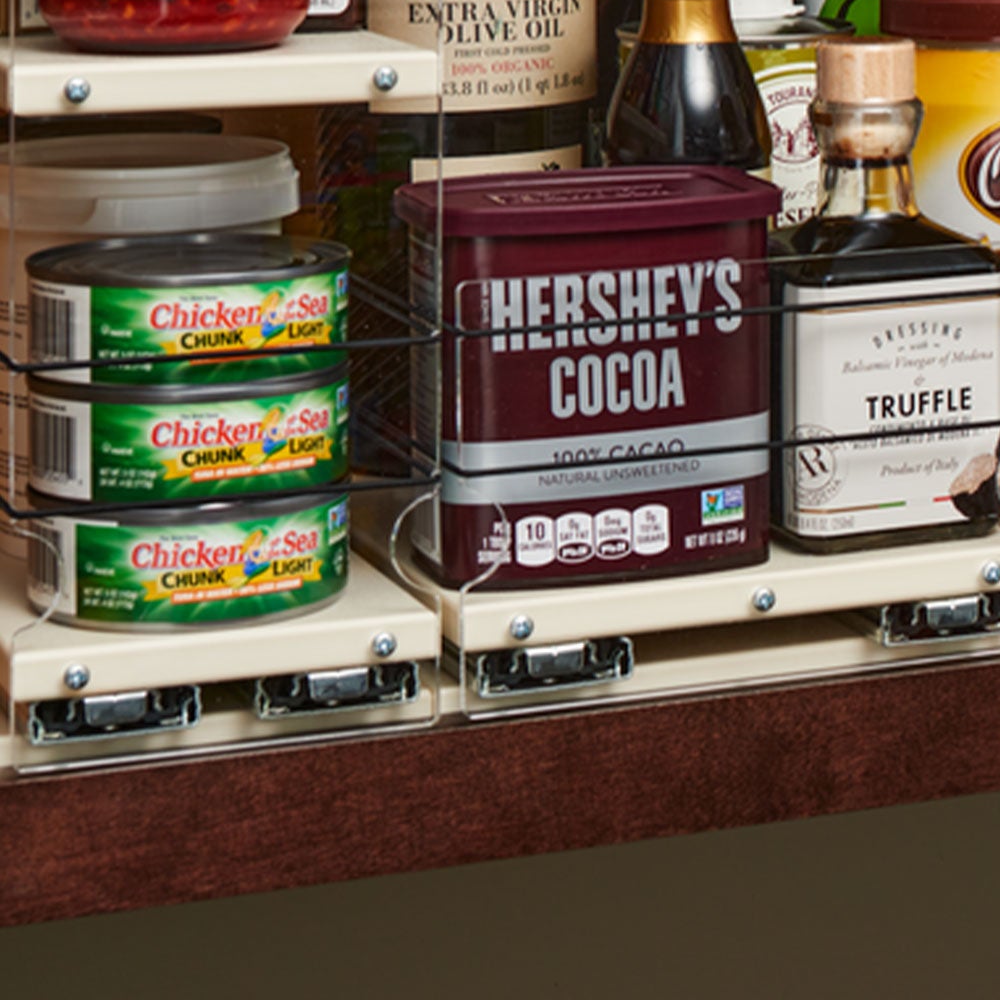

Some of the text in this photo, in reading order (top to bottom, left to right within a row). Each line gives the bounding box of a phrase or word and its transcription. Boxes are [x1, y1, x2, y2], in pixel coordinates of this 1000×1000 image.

[408, 1, 497, 25] EXTRA
[525, 18, 565, 39] OIL
[491, 57, 555, 74] ORGANIC
[150, 300, 262, 330] Chicken
[297, 293, 328, 320] Sea
[491, 257, 743, 353] HERSHEY'S
[181, 321, 325, 350] CHUNK LIGHT
[872, 321, 962, 350] DRESSING
[841, 348, 994, 375] Balsamic Vinegar of Modena
[550, 347, 686, 419] COCOA
[866, 386, 973, 420] TRUFFLE
[151, 418, 263, 448] Chicken
[298, 408, 329, 431] Sea
[181, 447, 246, 467] CHUNK
[288, 436, 325, 454] LIGHT
[608, 438, 686, 460] CACAO
[538, 459, 700, 487] NATURAL UNSWEETENED
[879, 456, 959, 477] Product of Italy
[527, 521, 545, 540] 10
[131, 539, 244, 569] Chicken
[283, 530, 318, 557] Sea
[161, 569, 225, 589] CHUNK
[272, 558, 313, 577] LIGHT
